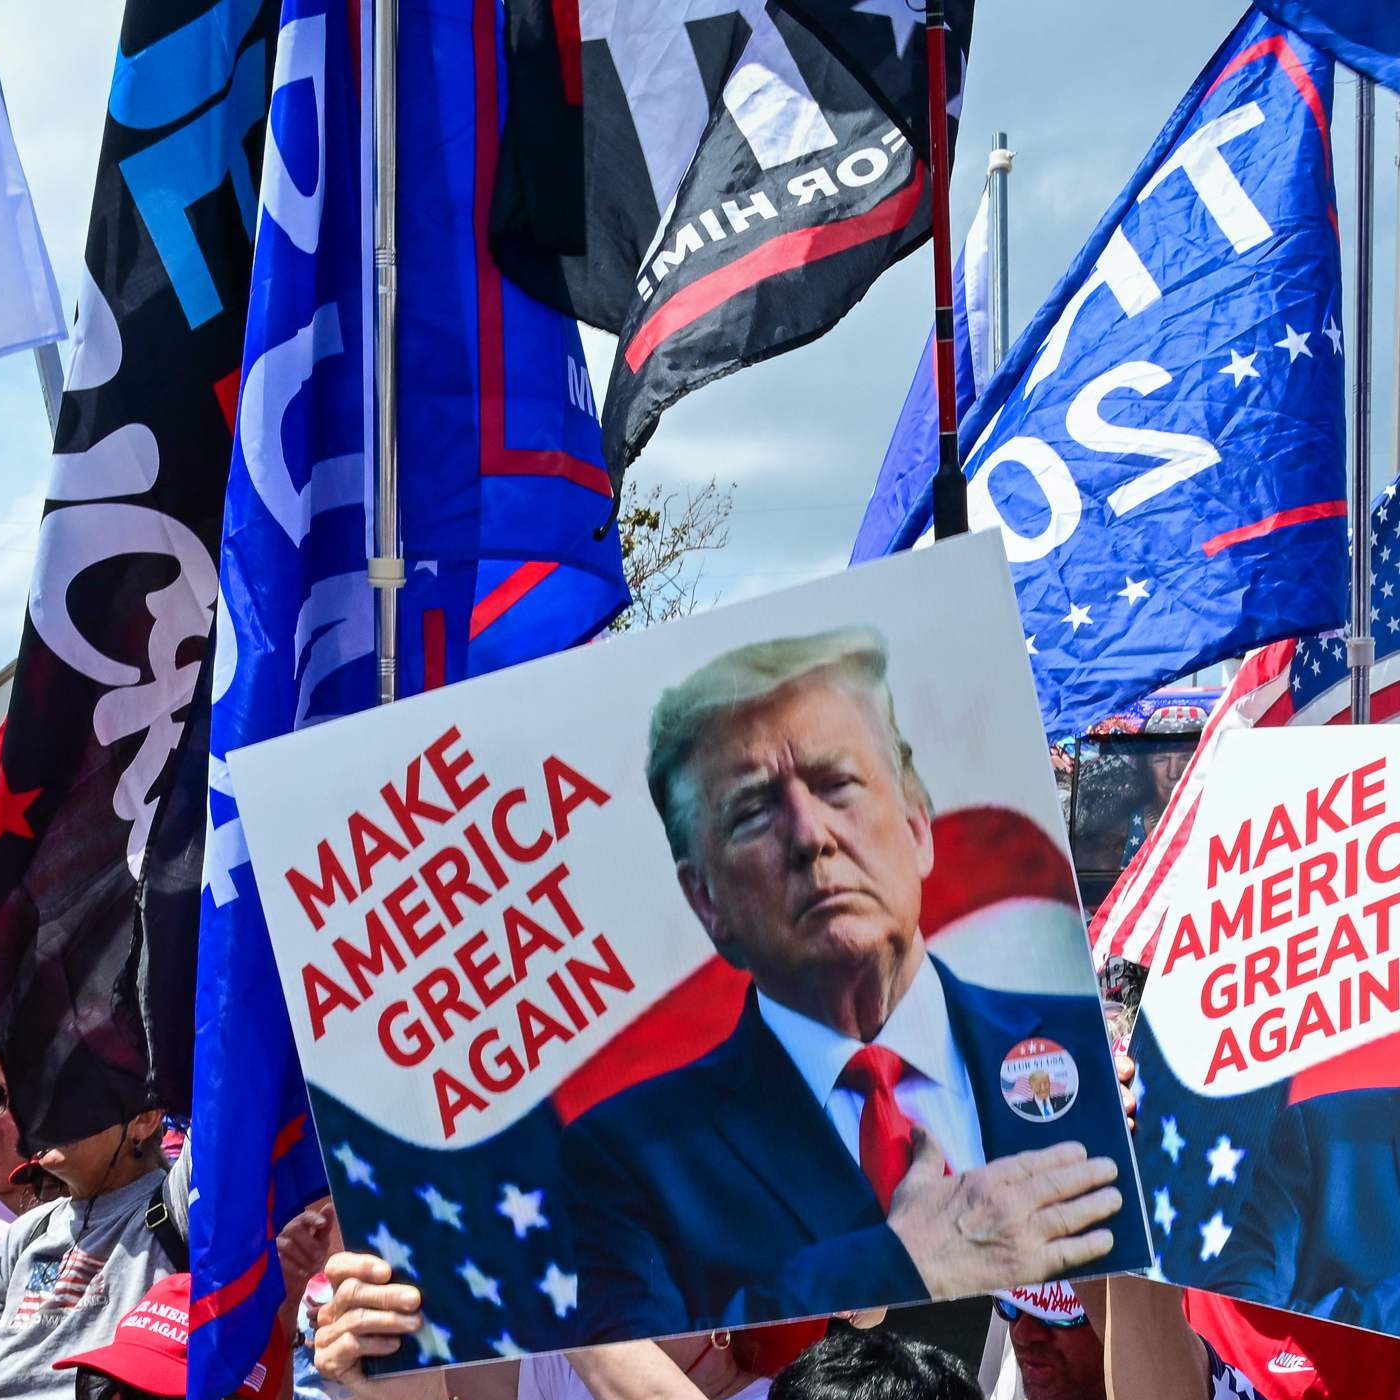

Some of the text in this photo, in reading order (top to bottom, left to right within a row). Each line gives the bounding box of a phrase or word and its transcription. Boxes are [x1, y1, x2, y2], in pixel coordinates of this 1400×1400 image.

[284, 725, 490, 932] MAKE
[300, 755, 612, 1041] AMERICA
[1206, 757, 1388, 890] MAKE
[377, 862, 585, 1068] GREAT
[431, 933, 637, 1139] AGAIN
[1203, 957, 1400, 1086] AGAIN
[1275, 1351, 1307, 1368] NIKE
